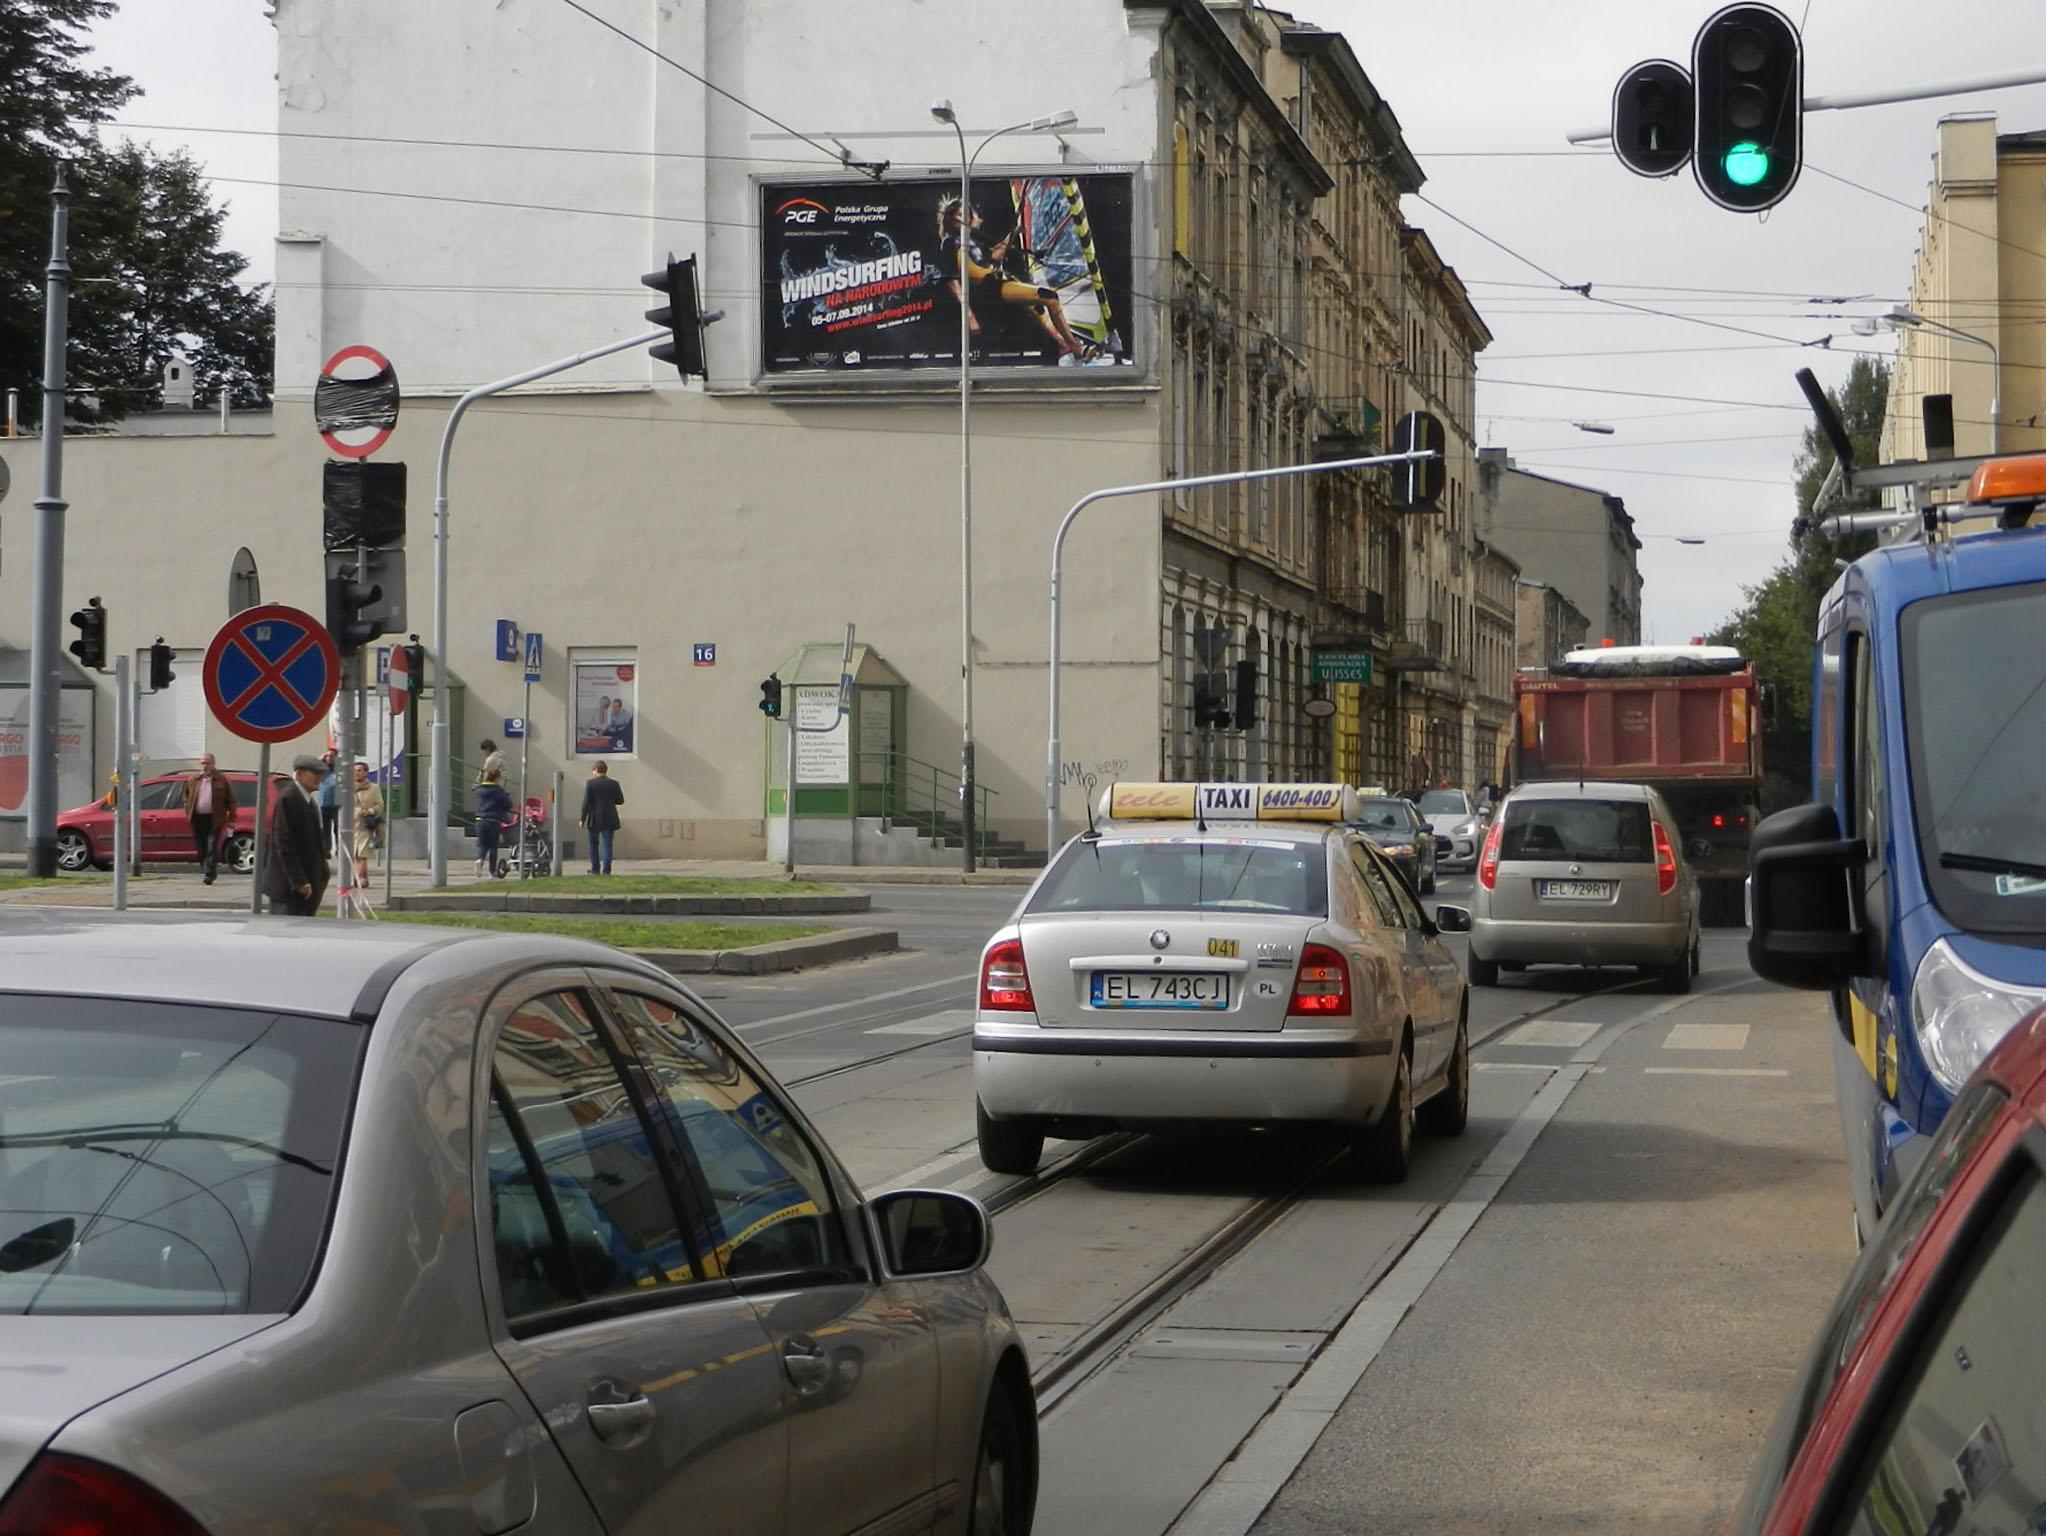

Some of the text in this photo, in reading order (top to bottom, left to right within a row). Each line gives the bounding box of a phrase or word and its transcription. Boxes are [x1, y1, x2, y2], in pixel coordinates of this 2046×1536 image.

[785, 210, 818, 223] PGE
[835, 204, 889, 215] Polska Grupa
[834, 213, 887, 225] Energetyczna
[780, 250, 922, 303] WINDSURFING
[825, 274, 923, 308] NA NARODOWYM
[827, 298, 933, 333] www.windsurfing2014.pl
[696, 648, 714, 661] 16
[1116, 788, 1333, 809] tele TAXI 6400-400
[1549, 883, 1609, 897] EL 729RY
[1208, 940, 1237, 957] 041
[1107, 976, 1220, 1001] EL 743CJ
[1259, 983, 1276, 994] PL
